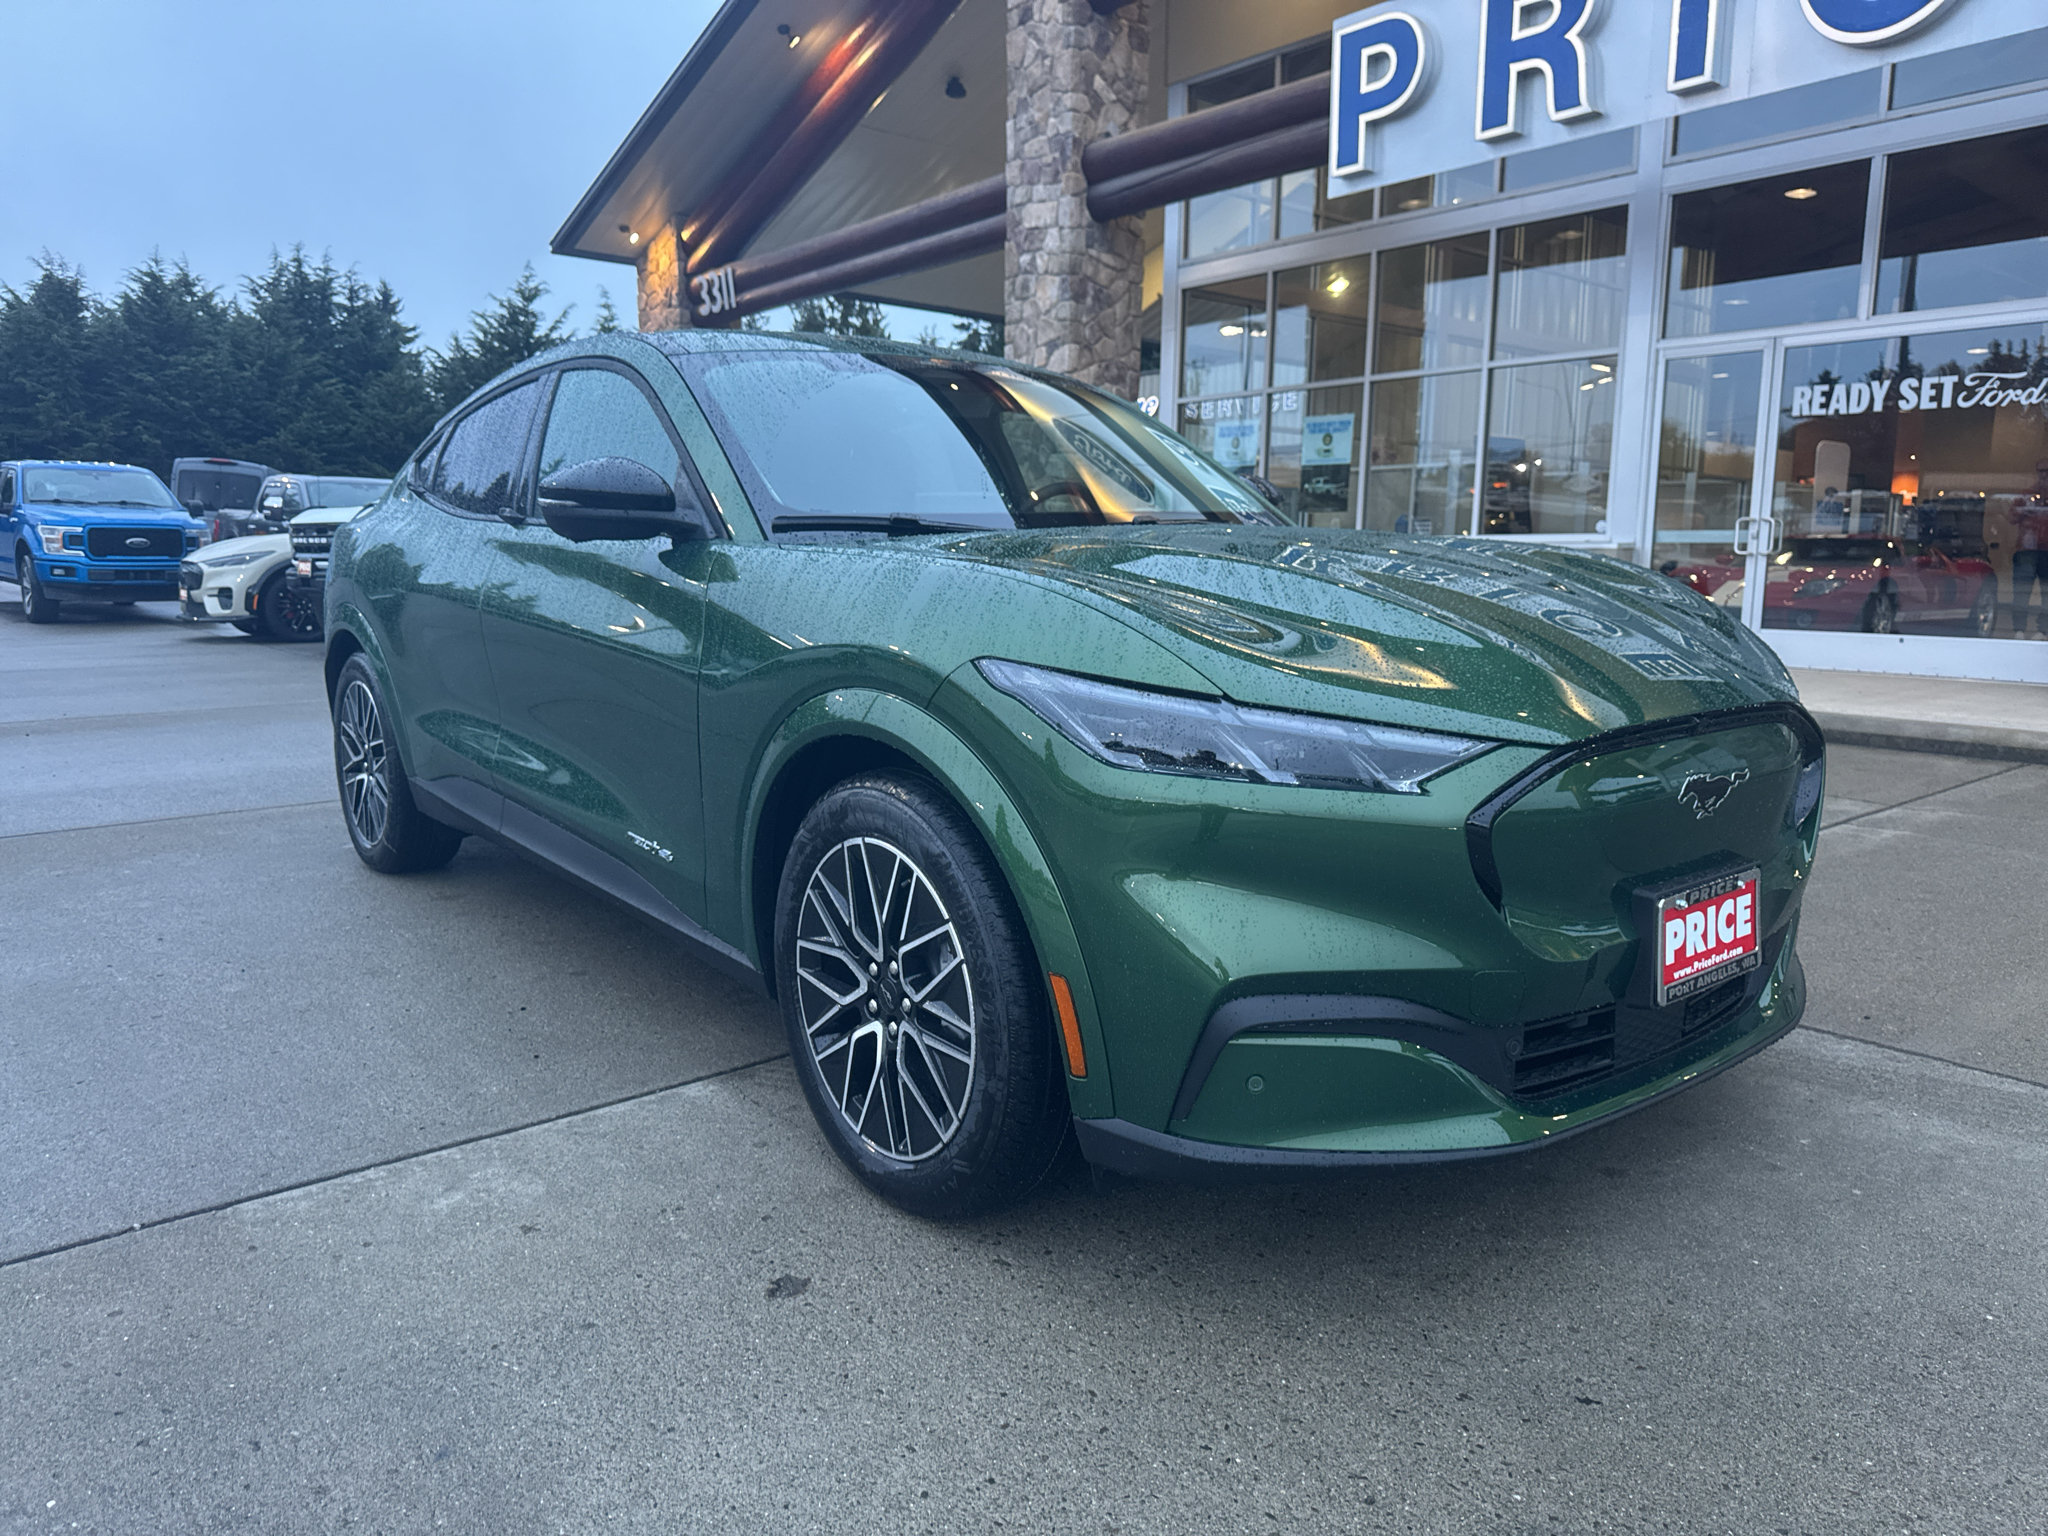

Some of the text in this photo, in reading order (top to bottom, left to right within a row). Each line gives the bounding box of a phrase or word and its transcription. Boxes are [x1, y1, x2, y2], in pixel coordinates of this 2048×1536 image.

[1331, 0, 1958, 178] PRI
[698, 265, 737, 316] 3311
[1791, 371, 2048, 417] READY SET Ford
[1690, 880, 1735, 905] PRICE
[1665, 893, 1752, 966] PRICE
[1668, 981, 1695, 999] PORT
[1741, 955, 1757, 969] WA
[1673, 947, 1744, 979] www.PriceFord.com
